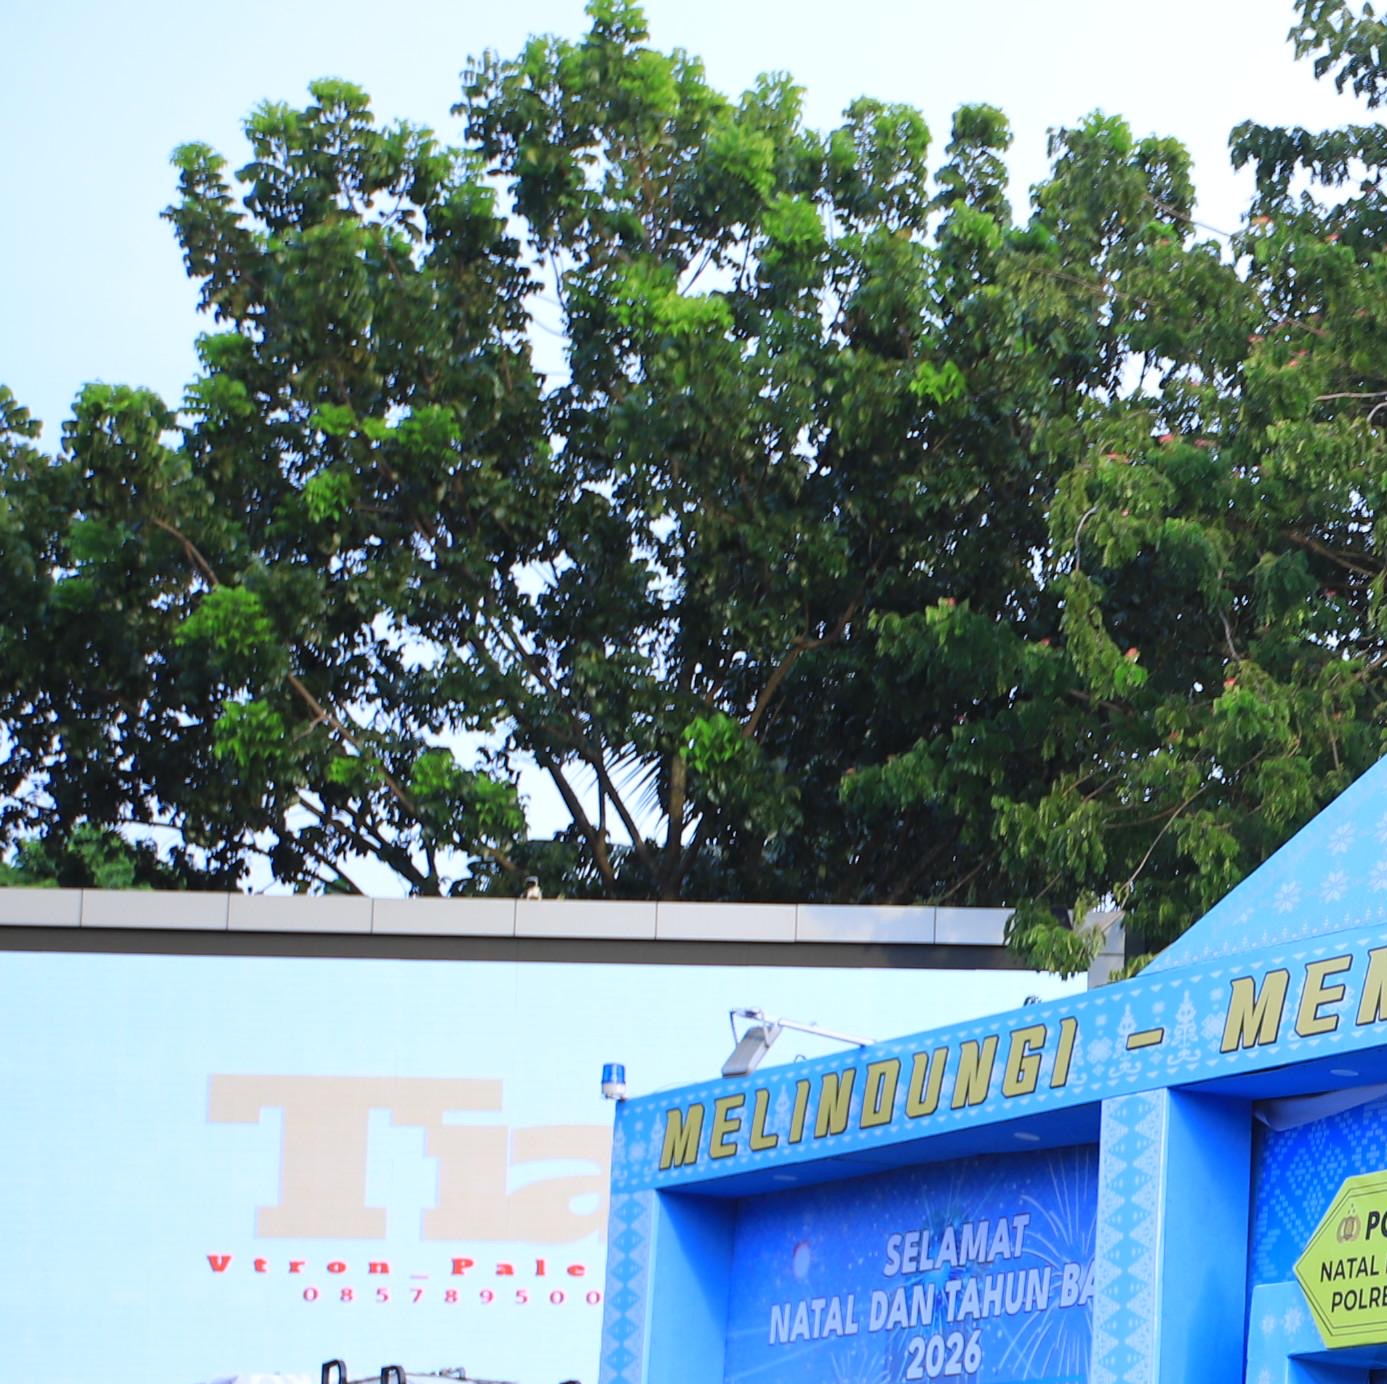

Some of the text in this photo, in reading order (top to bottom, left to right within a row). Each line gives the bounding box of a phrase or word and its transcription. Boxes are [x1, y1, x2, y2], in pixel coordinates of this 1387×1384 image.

[659, 1017, 1078, 1169] MELINDUNGI
[882, 1213, 1030, 1278] SELAMAT
[1320, 1256, 1379, 1282] NATAL
[768, 1294, 858, 1345] NATAL
[868, 1284, 935, 1333] DAN
[946, 1267, 1051, 1323] TAHUN
[905, 1329, 983, 1381] 2026
